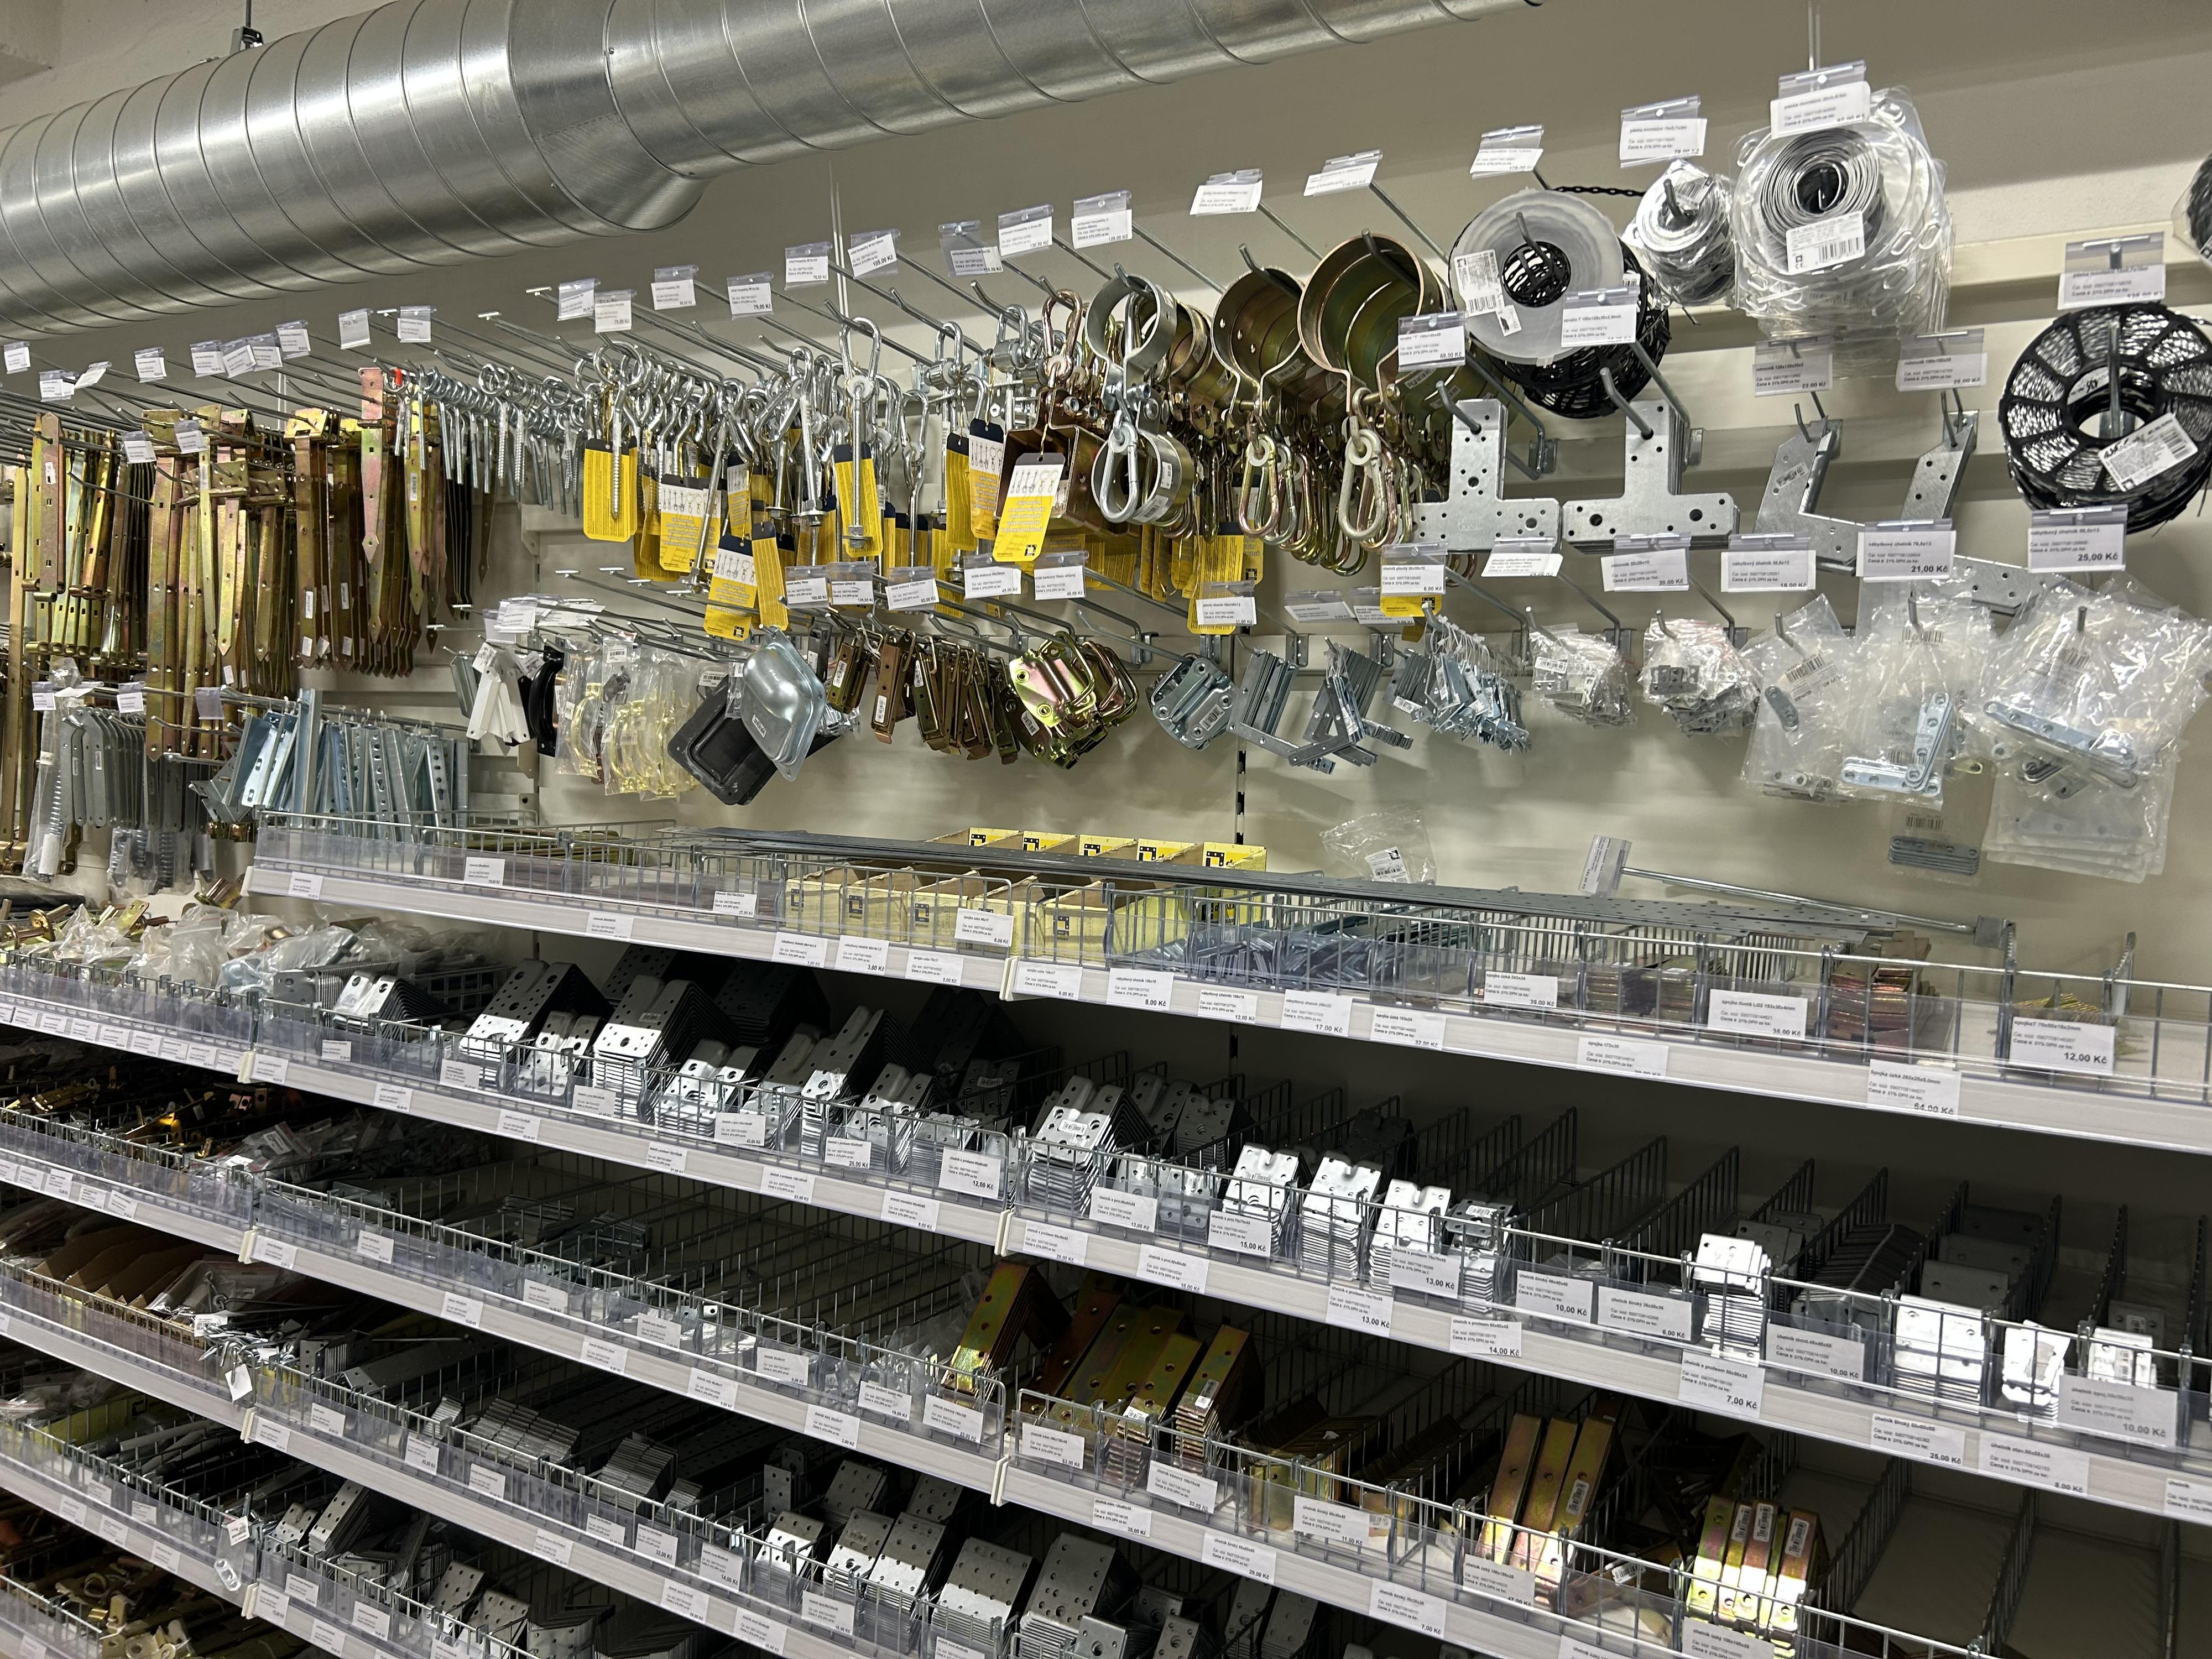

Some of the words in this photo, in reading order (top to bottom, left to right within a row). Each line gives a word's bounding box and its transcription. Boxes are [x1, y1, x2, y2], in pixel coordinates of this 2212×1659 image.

[2078, 553, 2102, 562] 25,00
[2105, 552, 2118, 560] Kč
[1315, 1024, 1332, 1032] 17,00
[2064, 1052, 2090, 1064] 12,00
[2094, 1055, 2107, 1065] Kč
[1941, 1106, 1953, 1115] Kč
[973, 1180, 985, 1188] 12,00
[1240, 1241, 1256, 1250] 15,00
[1426, 1277, 1443, 1287] 13,00
[1556, 1304, 1574, 1313] 10,00
[1577, 1307, 1587, 1316] Kč
[1362, 1316, 1379, 1326] 13,00
[1381, 1320, 1389, 1328] Kč
[1662, 1328, 1675, 1337] 6,00
[1489, 1347, 1507, 1355] 14,00
[1829, 1367, 1847, 1376] 10,00
[1726, 1395, 1743, 1406] 7,00
[1746, 1400, 1757, 1409] Kč
[2124, 1422, 2148, 1434] 10,00
[2152, 1428, 2166, 1438] Kč
[1249, 1568, 1261, 1578] 29,00
[1421, 1624, 1432, 1632] 7,00
